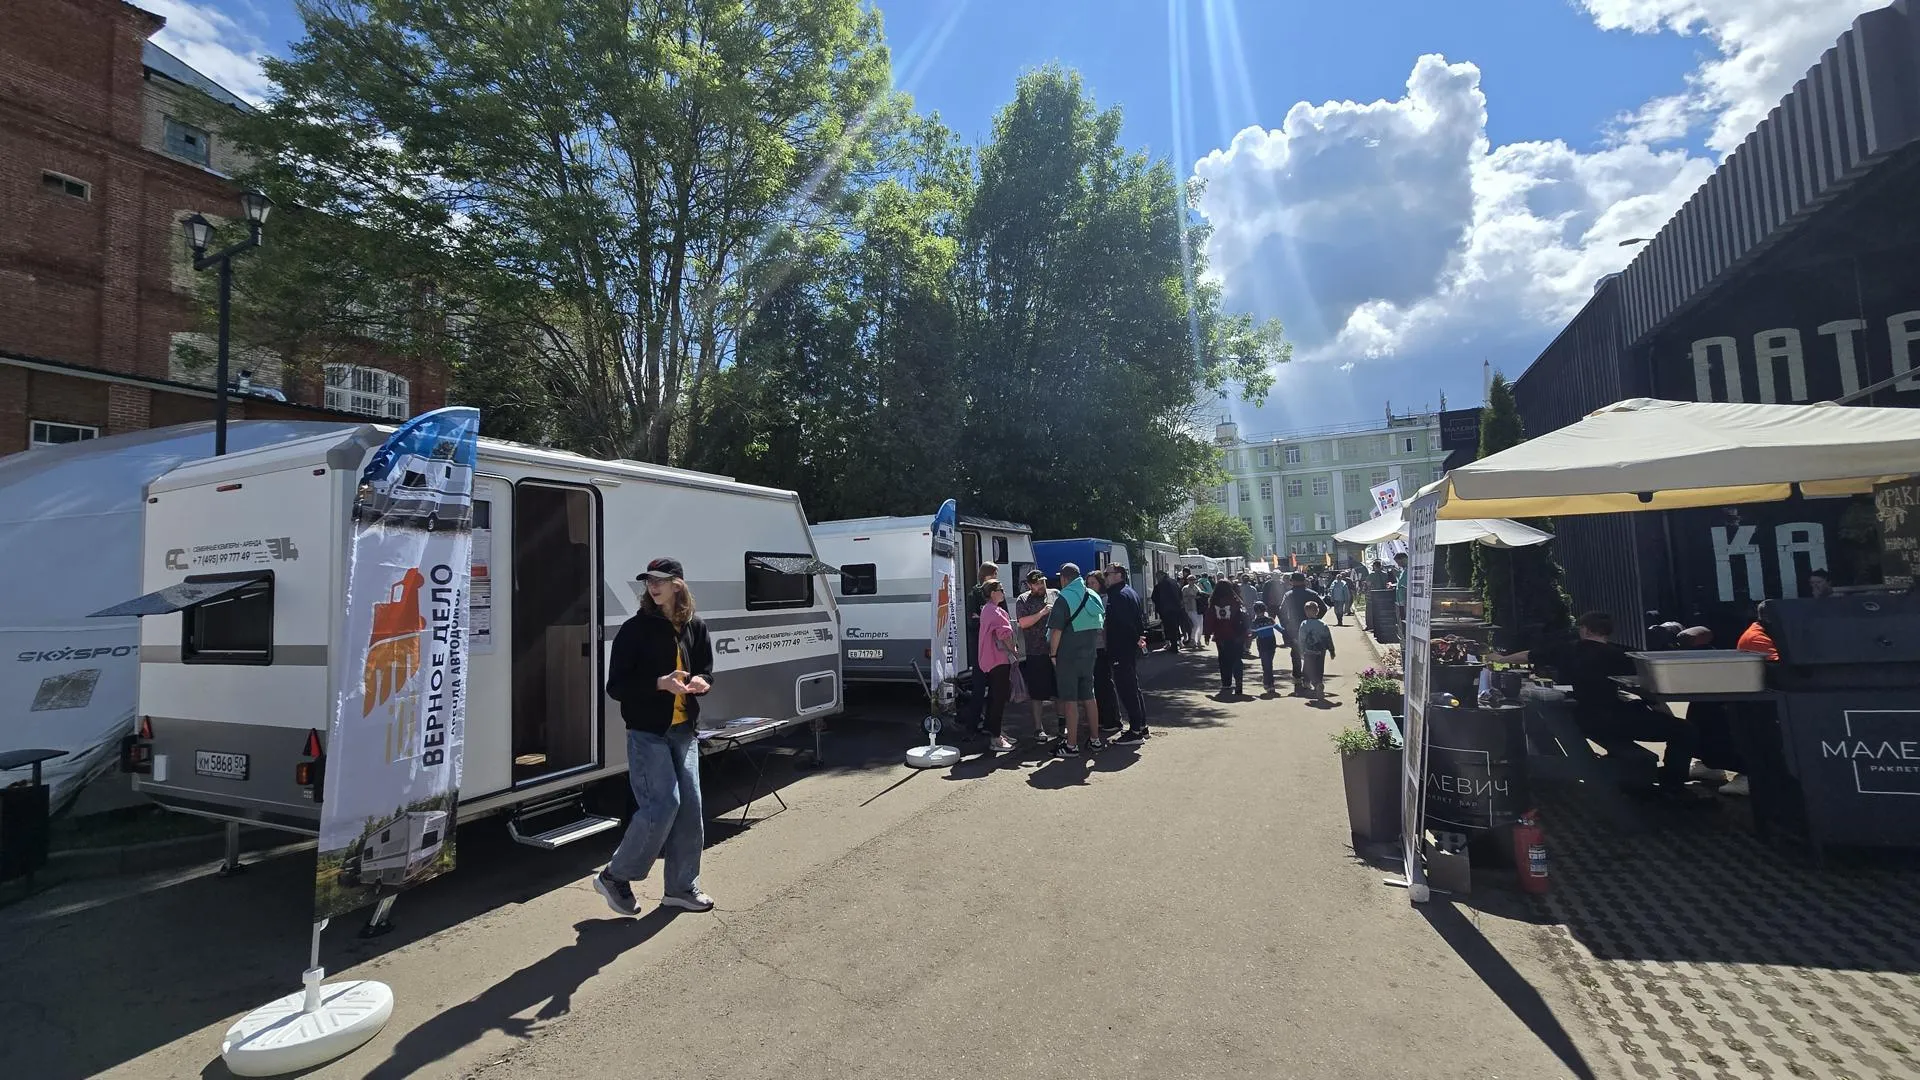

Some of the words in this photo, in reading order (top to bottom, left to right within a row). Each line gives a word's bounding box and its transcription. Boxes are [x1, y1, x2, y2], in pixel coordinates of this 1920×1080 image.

[202, 554, 219, 566] (495)
[229, 552, 241, 561] 777
[241, 551, 251, 561] 49
[430, 564, 453, 645] ДЕЛО
[755, 641, 772, 652] (495)
[773, 640, 781, 648] 99
[781, 639, 792, 647] 777
[792, 638, 801, 646] 49
[422, 652, 444, 767] ВЕРНОЕ
[1426, 772, 1509, 796] ЛЕВИЧ
